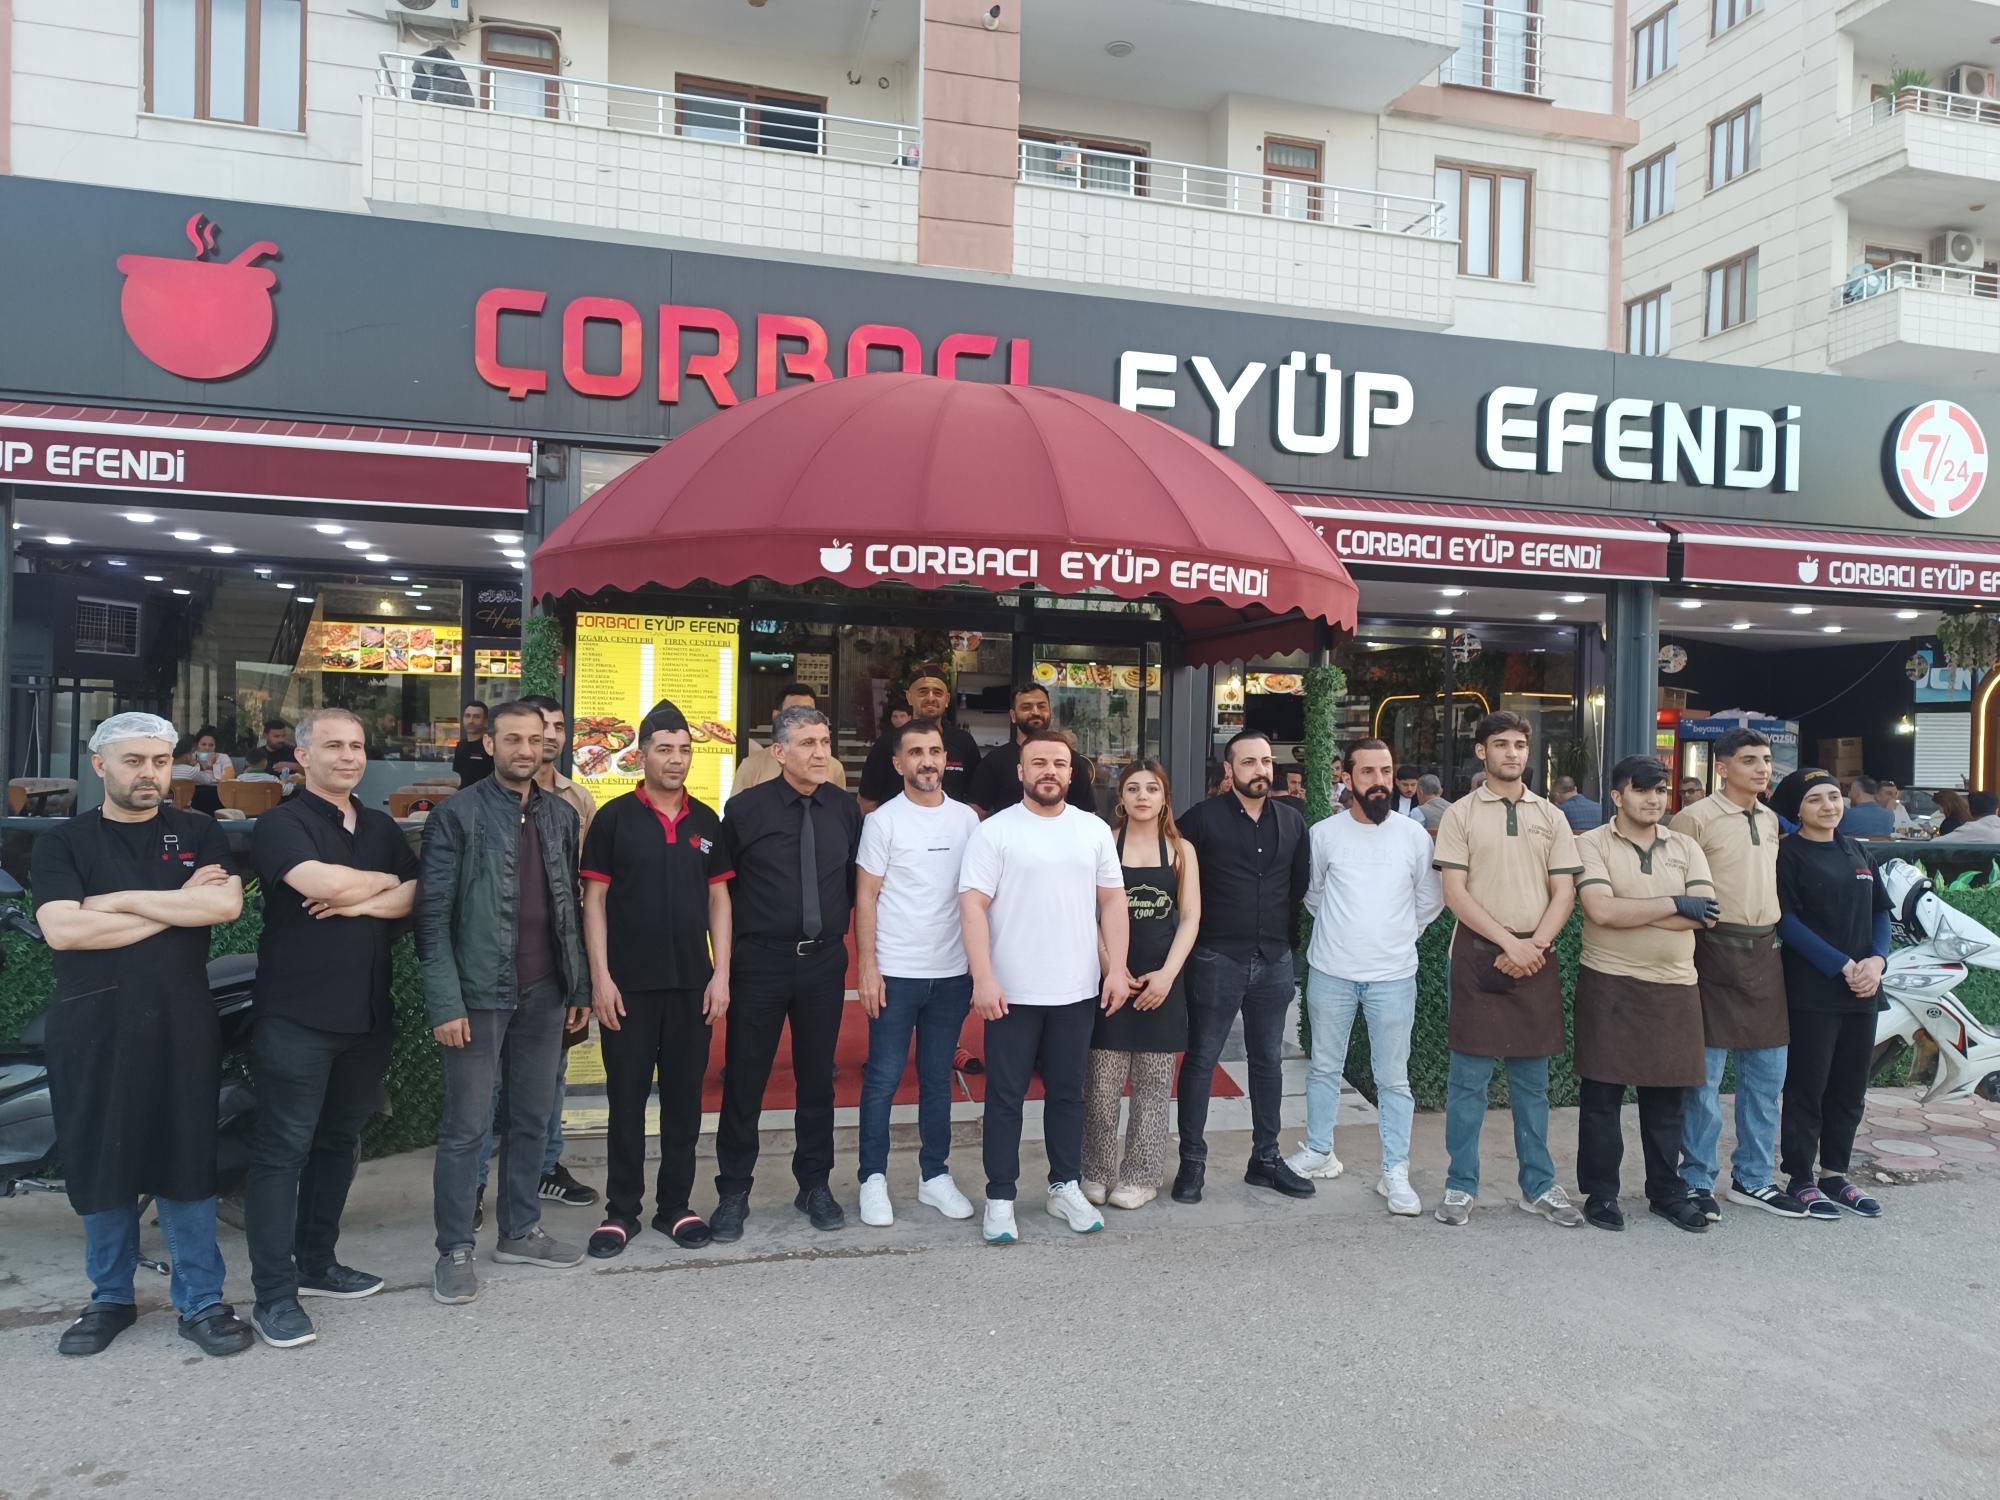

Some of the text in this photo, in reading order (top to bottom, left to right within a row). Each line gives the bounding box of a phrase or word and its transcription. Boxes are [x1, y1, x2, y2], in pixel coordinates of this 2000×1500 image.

[1119, 350, 1414, 458] EYÜP
[0, 441, 33, 472] P
[1918, 433, 1969, 486] 7/24
[1336, 529, 1442, 559] ÇORBACI
[1449, 533, 1514, 564] EYÜP
[865, 544, 1038, 576] ÇORBACI
[1060, 548, 1160, 584] EYÜP
[1828, 561, 1915, 588] ÇORBACI
[1920, 563, 1975, 591] EYÜP
[645, 616, 685, 631] EYÜP
[1134, 909, 1154, 919] 1900
